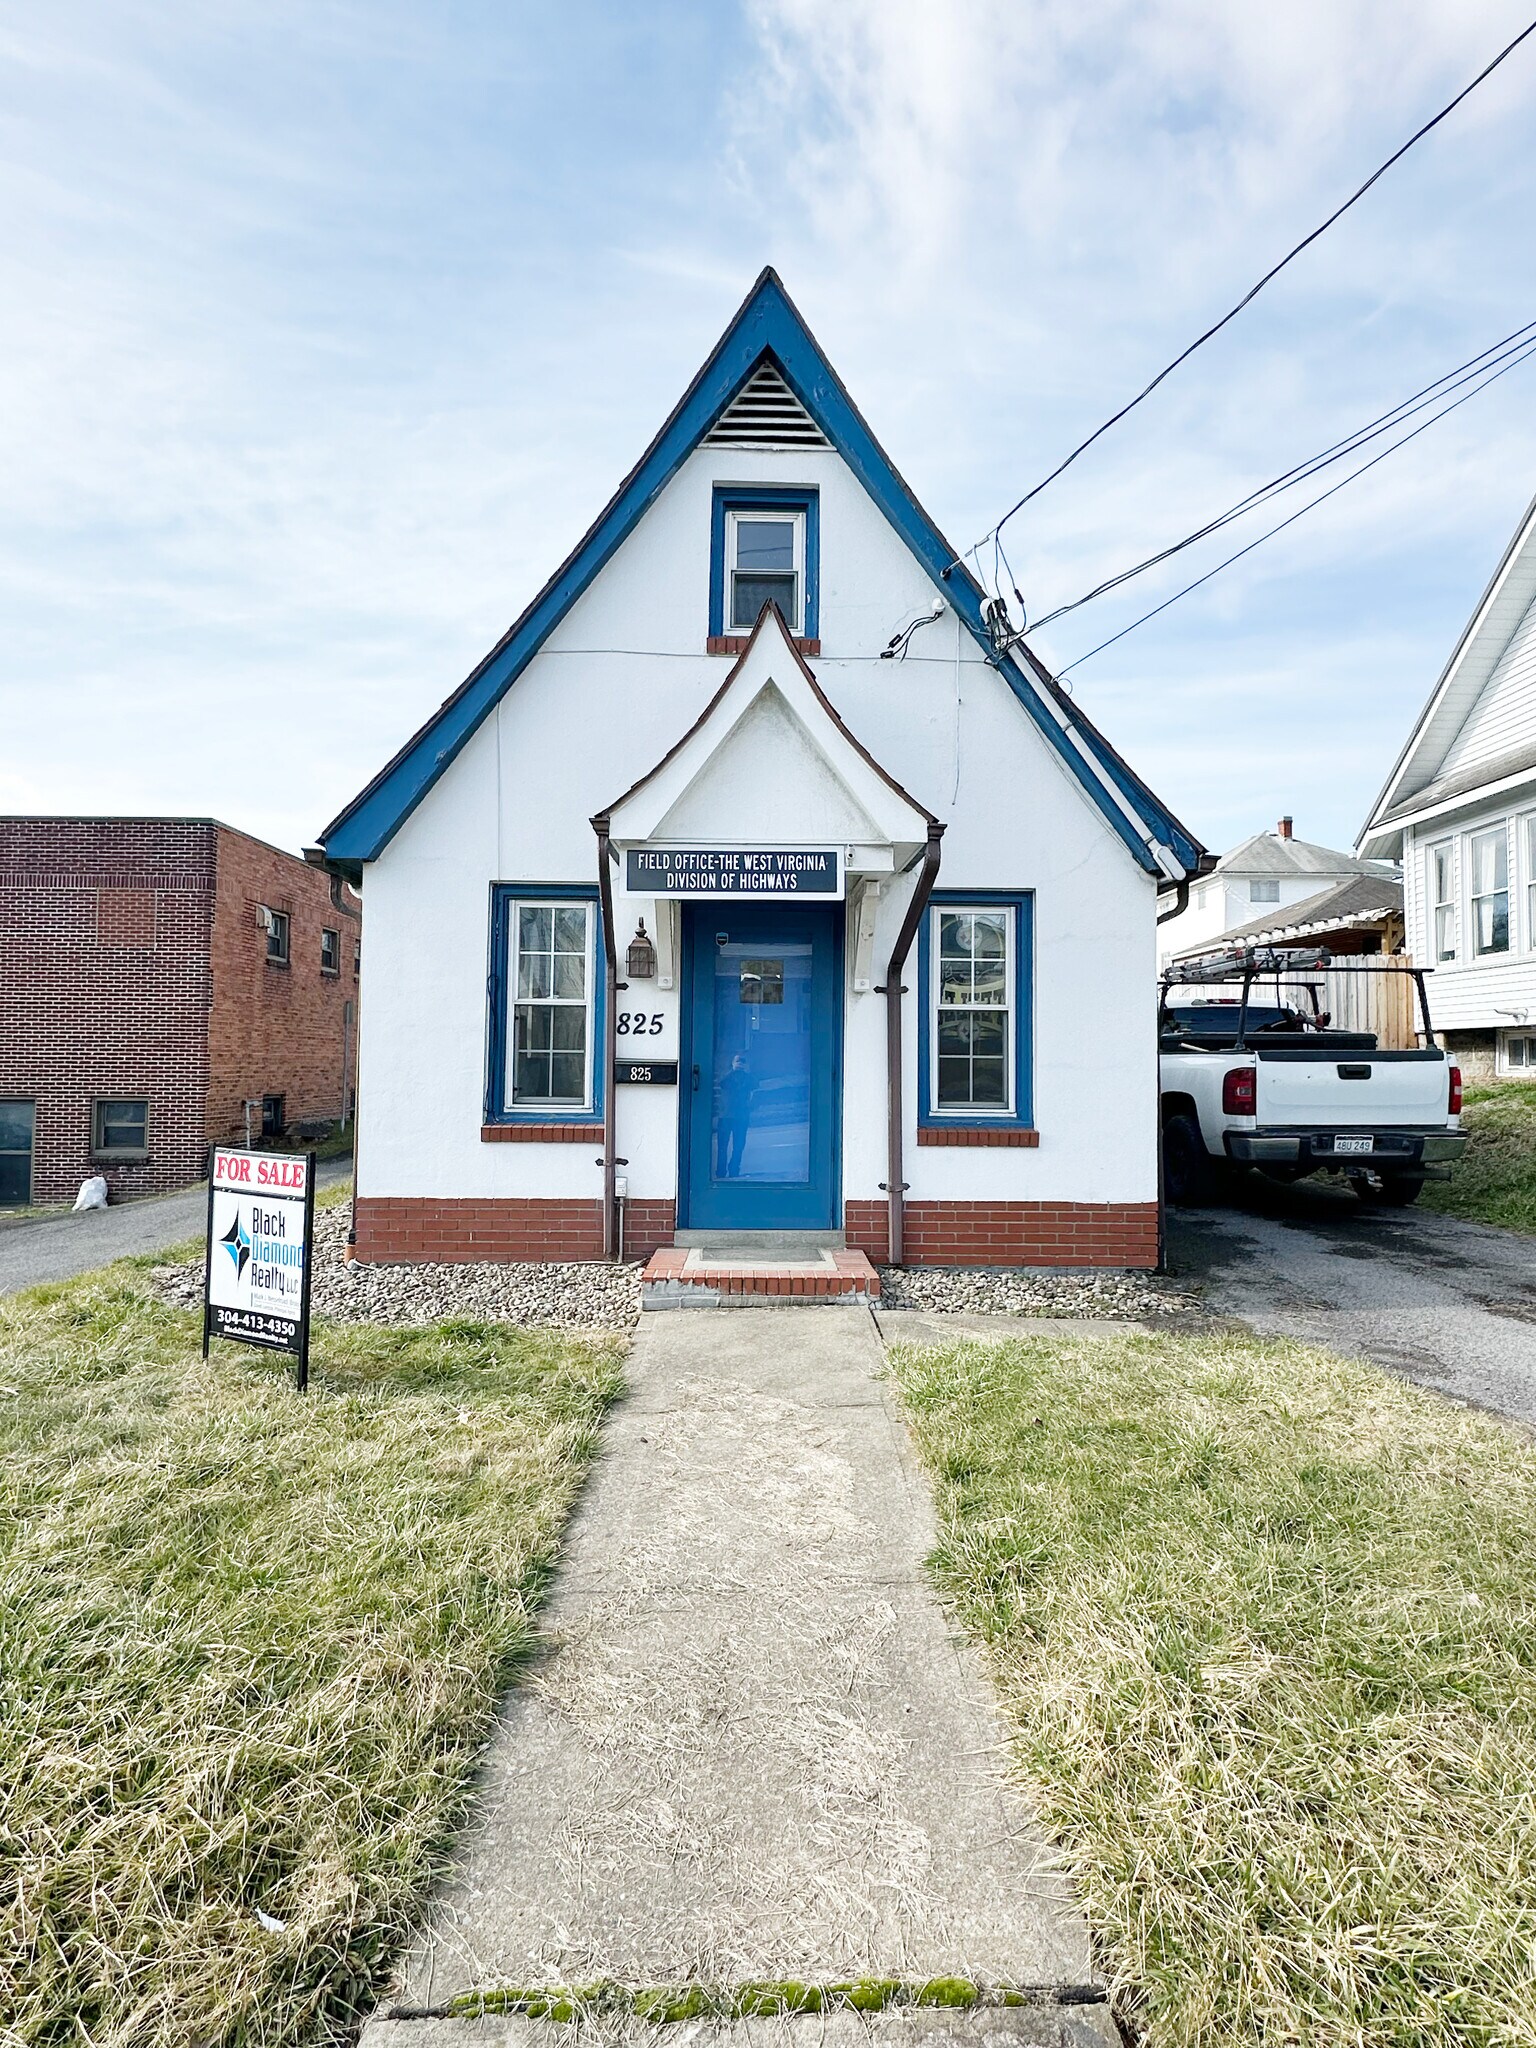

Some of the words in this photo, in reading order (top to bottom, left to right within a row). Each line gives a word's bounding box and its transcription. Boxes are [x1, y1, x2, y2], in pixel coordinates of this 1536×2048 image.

[638, 853, 670, 870] FIELD
[743, 854, 774, 871] WEST
[776, 855, 826, 871] VIRGINIA
[666, 872, 716, 889] DIVISION
[720, 873, 736, 889] OF
[739, 873, 798, 890] HIGHWAYS
[616, 1012, 665, 1036] 825
[630, 1066, 652, 1081] 825
[216, 1156, 252, 1182] FOR
[257, 1160, 305, 1189] SALE
[252, 1207, 286, 1238] Black
[251, 1262, 285, 1296] Realty
[216, 1309, 296, 1337] 304-413-4350
